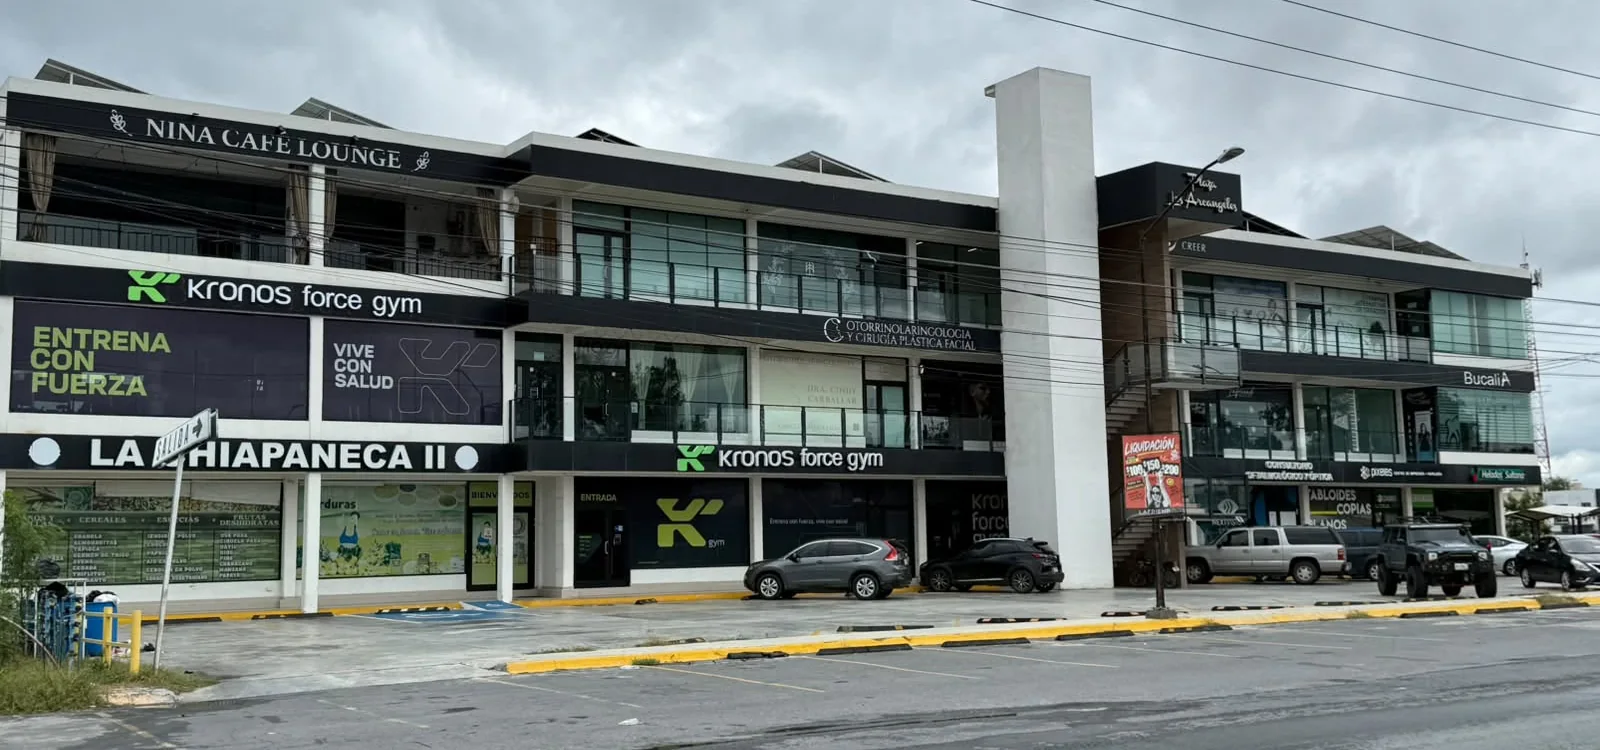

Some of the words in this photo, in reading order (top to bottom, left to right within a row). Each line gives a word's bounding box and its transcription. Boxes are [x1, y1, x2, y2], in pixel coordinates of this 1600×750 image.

[146, 117, 214, 145] NINA
[298, 141, 401, 168] LOUNGE
[1181, 241, 1207, 252] CREER
[302, 284, 362, 310] force
[372, 294, 422, 318] gym
[33, 326, 171, 354] ENTRENA
[846, 332, 852, 342] Y
[944, 338, 977, 351] FACIAL
[333, 343, 375, 359] VIVE
[30, 349, 95, 373] CON
[333, 358, 373, 374] CON
[31, 371, 148, 397] FUERZA
[334, 373, 394, 390] SALUD
[156, 424, 190, 461] SALIDA
[1125, 436, 1175, 455] LIQUIDACIÓN
[90, 438, 145, 468] LA
[158, 440, 413, 469] HIAPANECA
[424, 444, 447, 470] II
[800, 448, 843, 467] force
[847, 451, 883, 471] gym
[1143, 458, 1160, 471] $150
[472, 491, 530, 499] BIENVDOS
[580, 494, 617, 502] ENTRADA
[1308, 488, 1357, 501] ABLOIDES
[1336, 503, 1372, 515] COPIAS
[708, 538, 725, 548] gym
